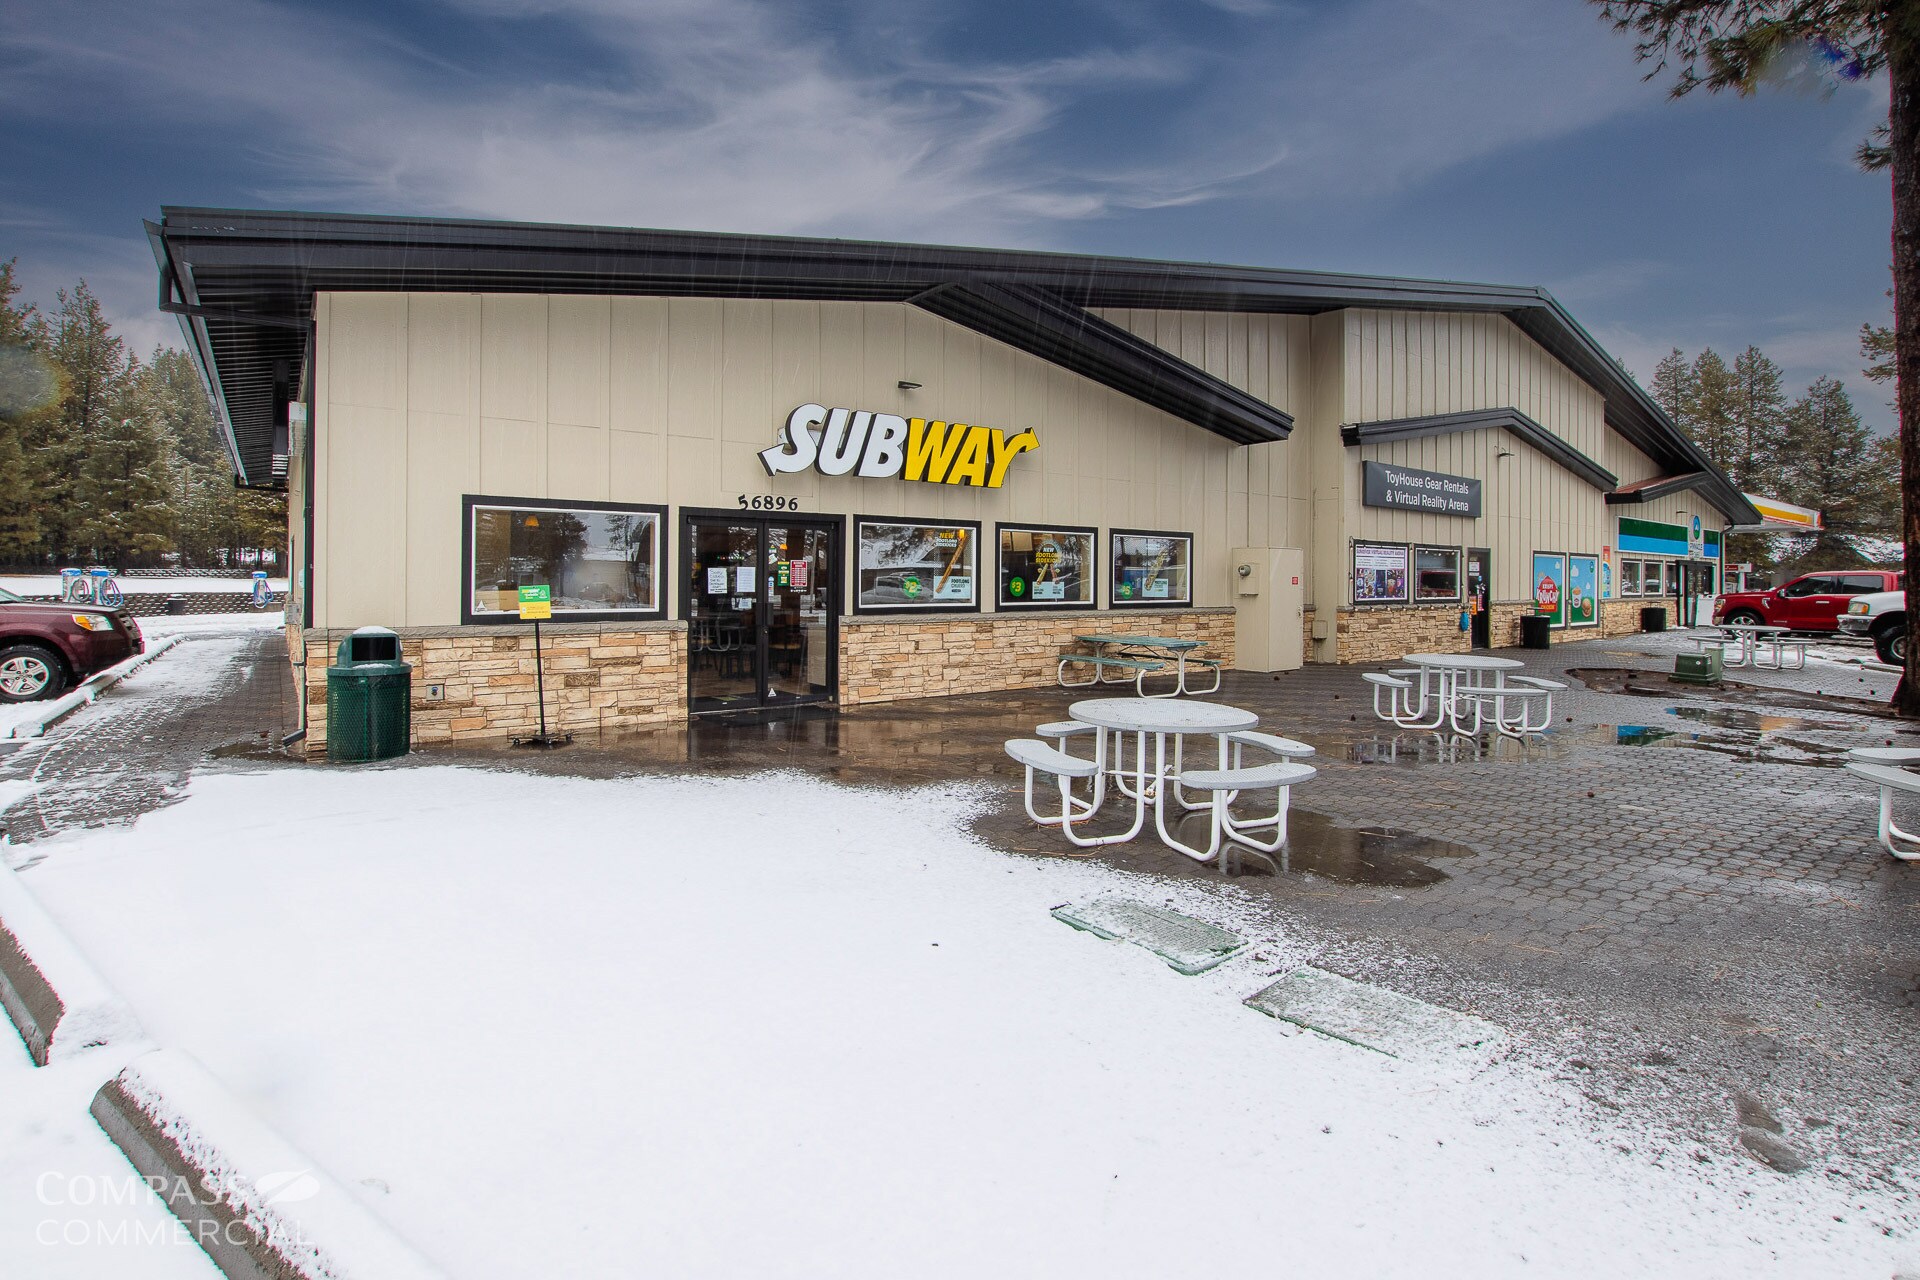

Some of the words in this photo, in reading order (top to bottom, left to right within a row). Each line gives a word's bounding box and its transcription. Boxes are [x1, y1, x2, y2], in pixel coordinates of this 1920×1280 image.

[757, 403, 1040, 488] SUBWAY
[1385, 470, 1423, 488] ToyHouse
[1425, 477, 1442, 492] Gear
[1444, 480, 1469, 495] Rentals
[738, 494, 798, 511] 56896
[1386, 490, 1393, 503] &
[1394, 490, 1420, 506] Virtual
[1421, 494, 1446, 511] Reality
[1448, 498, 1469, 512] Arena
[1011, 581, 1021, 592] $3
